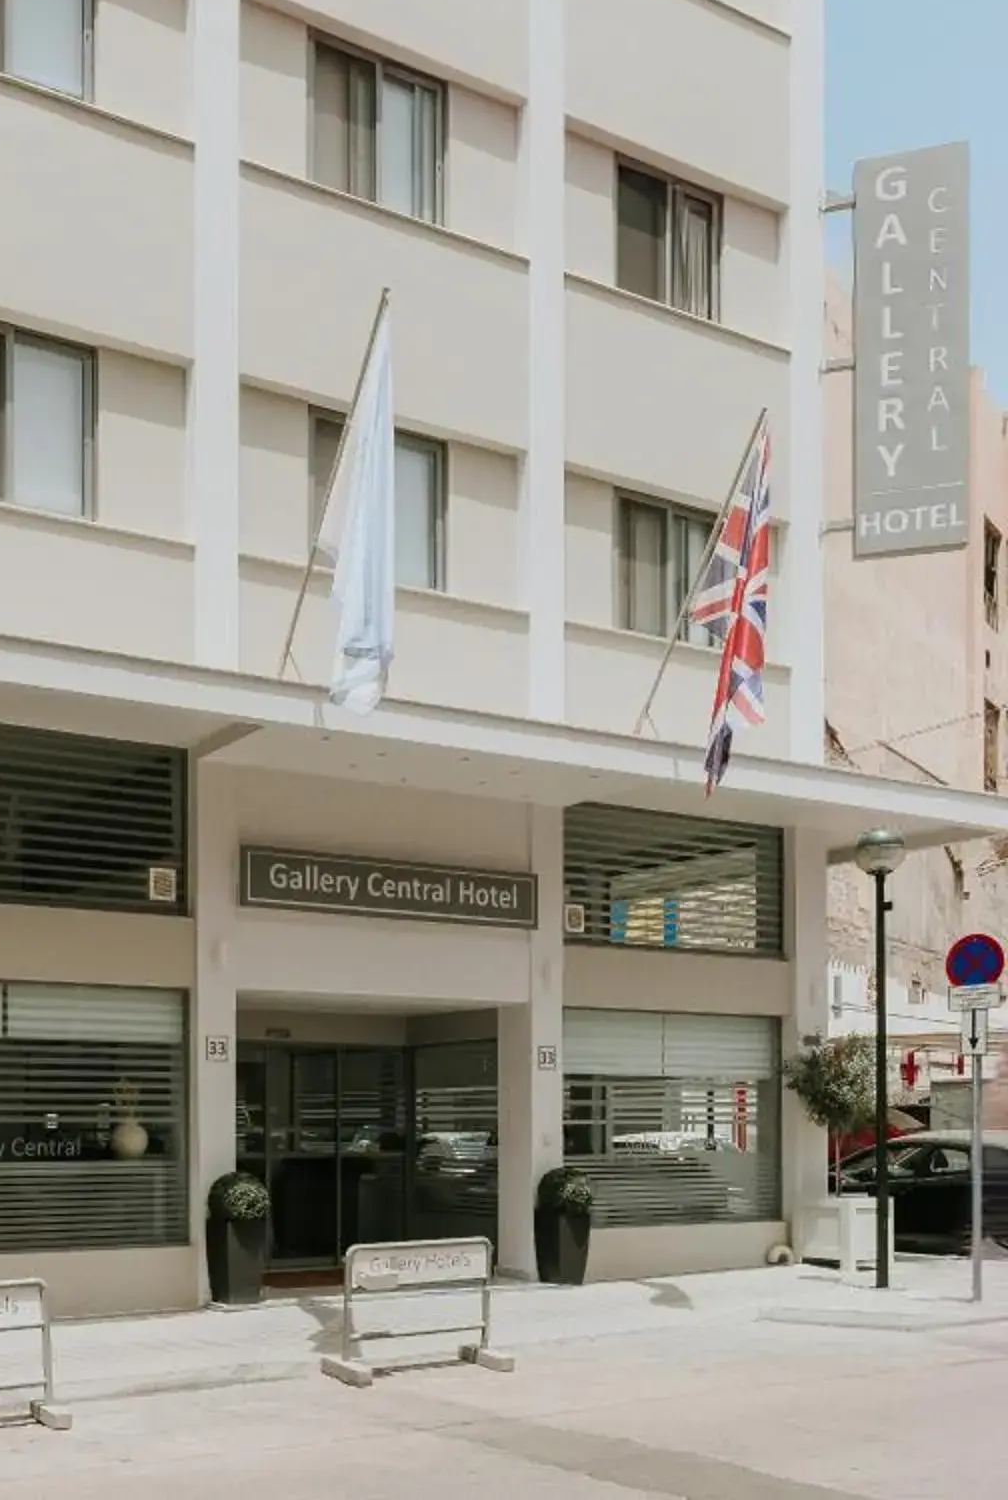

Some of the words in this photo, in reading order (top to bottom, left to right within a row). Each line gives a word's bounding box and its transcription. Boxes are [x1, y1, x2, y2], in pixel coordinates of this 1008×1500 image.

[874, 165, 908, 478] GALLERY
[927, 186, 949, 453] CENTRAL
[859, 502, 965, 538] HOTEL
[269, 863, 359, 900] Gallery
[367, 872, 452, 904] Central
[459, 880, 518, 909] Hotel
[209, 1041, 225, 1056] 33
[11, 1136, 82, 1157] Central
